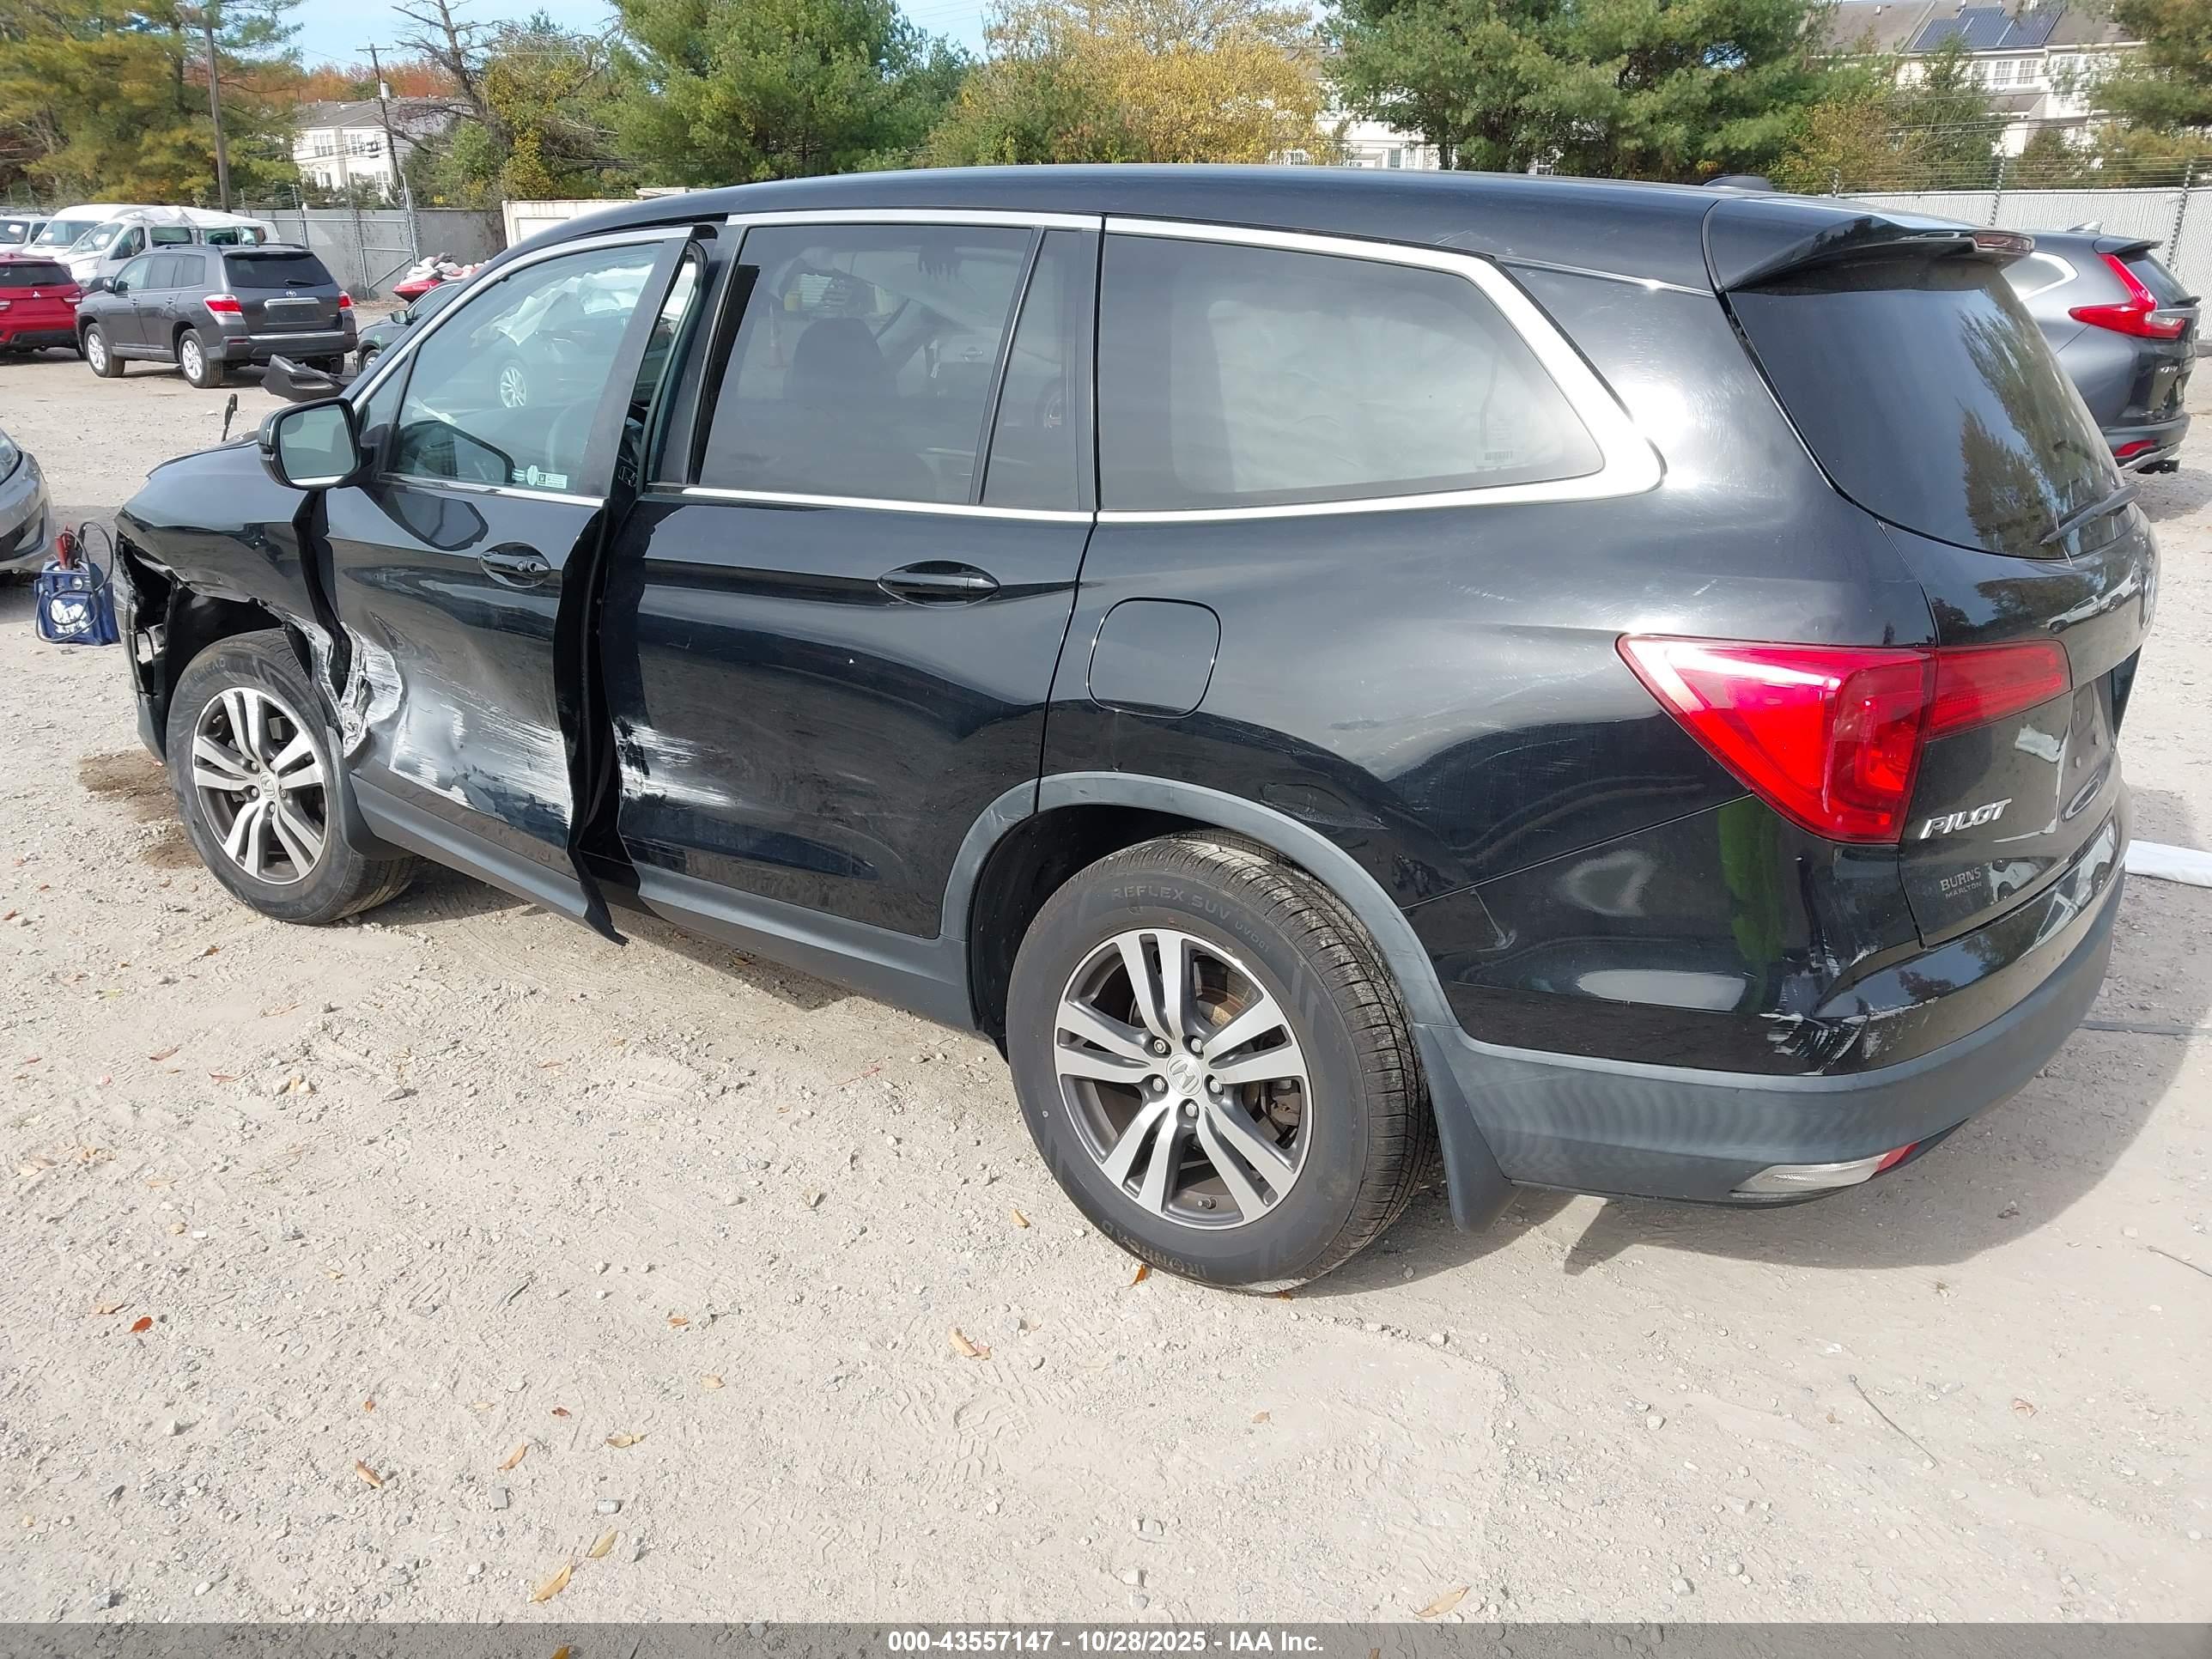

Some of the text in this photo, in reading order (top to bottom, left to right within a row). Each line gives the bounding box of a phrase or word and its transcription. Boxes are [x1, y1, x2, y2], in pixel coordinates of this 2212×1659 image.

[1919, 798, 2013, 840] PILOT
[1940, 866, 1982, 891] BURNS
[1945, 881, 1983, 900] MARLTON
[1113, 885, 1184, 901] REFLEX
[1191, 895, 1231, 921] SUV
